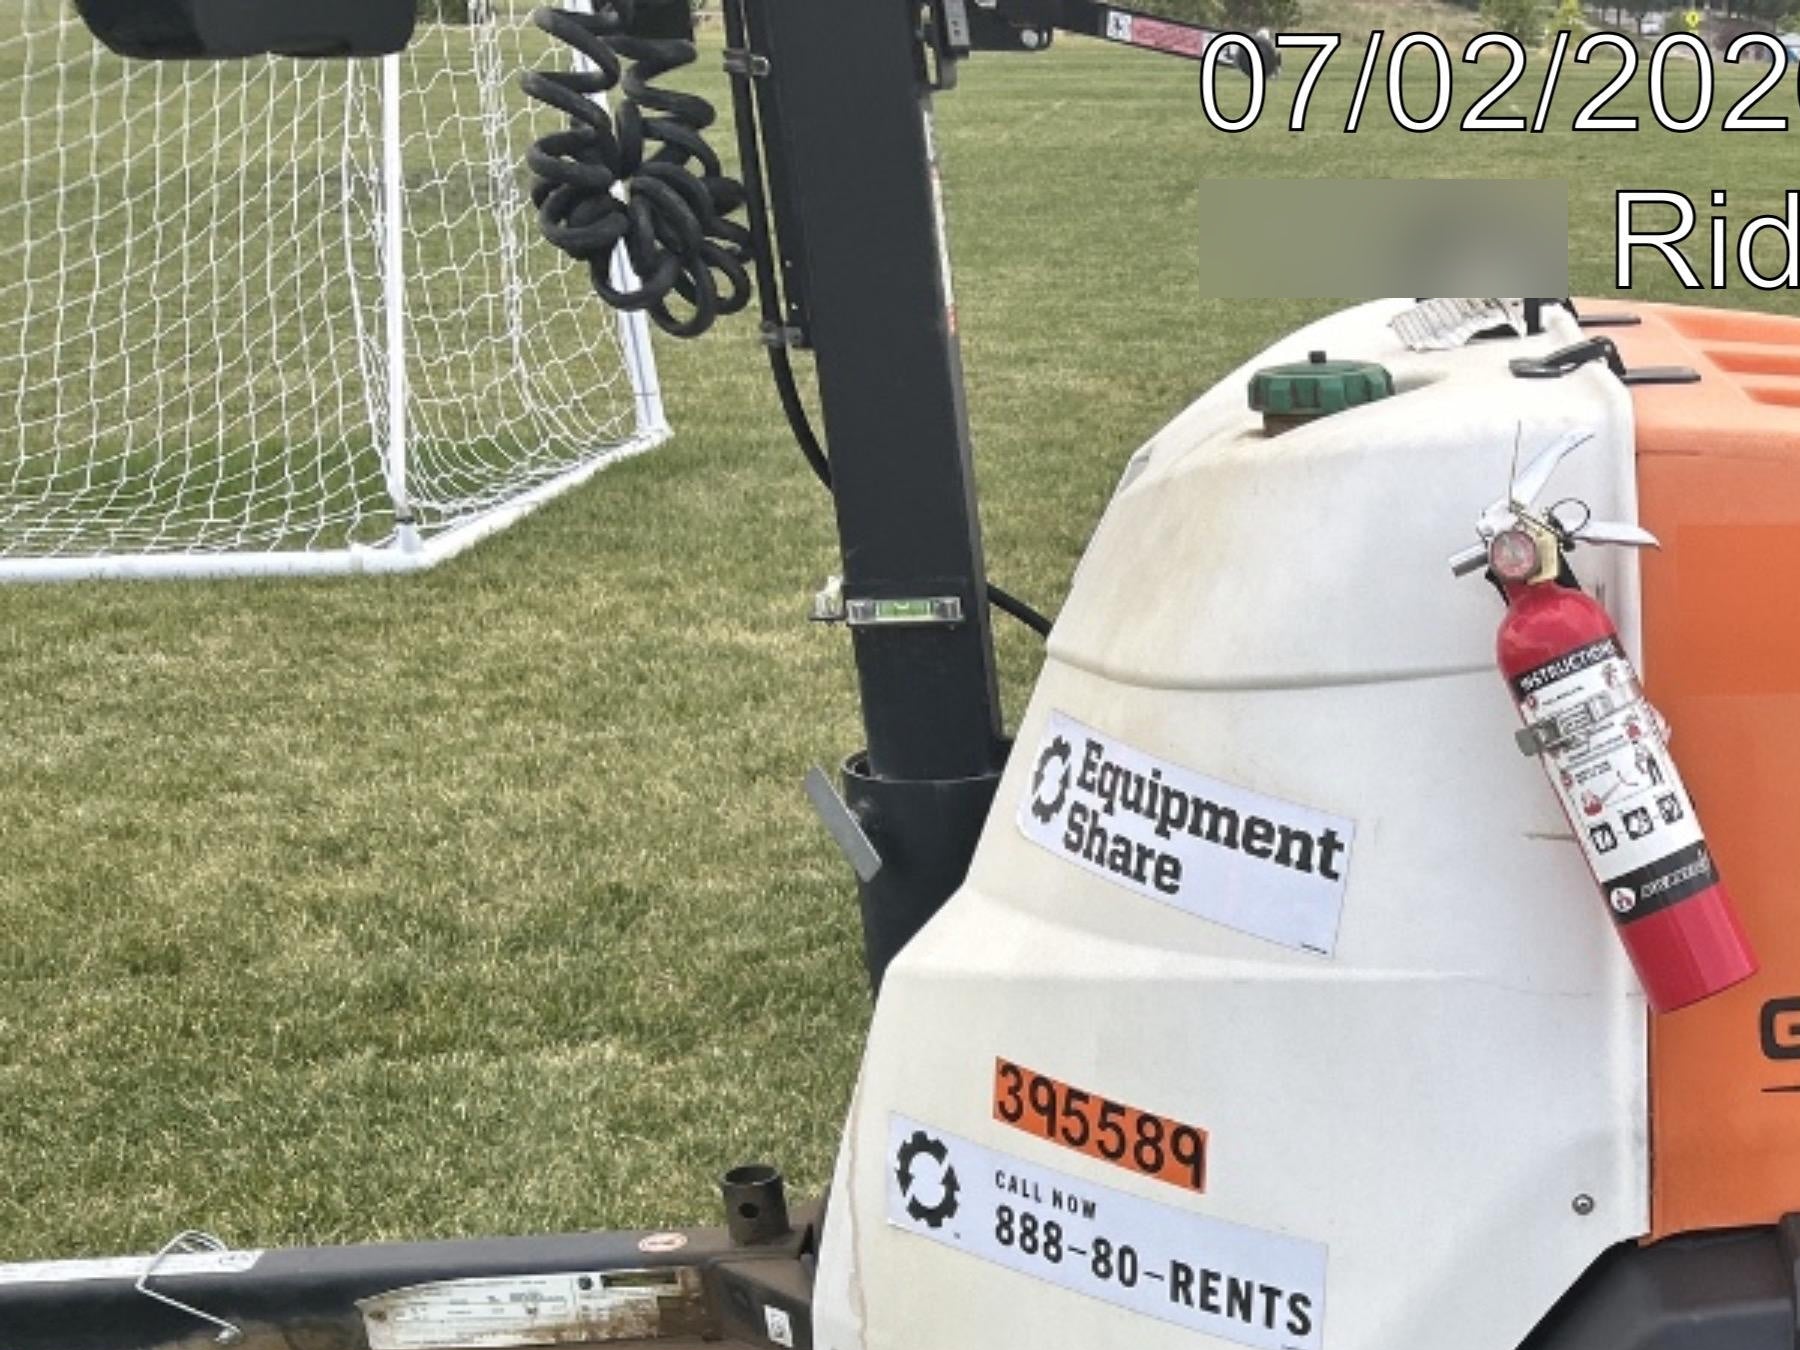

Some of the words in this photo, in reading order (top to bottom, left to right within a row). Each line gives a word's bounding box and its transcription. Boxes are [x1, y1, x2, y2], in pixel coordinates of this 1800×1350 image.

[1062, 799, 1183, 895] Share
[1075, 736, 1345, 883] Equipment
[997, 1061, 1208, 1191] 395589
[994, 1169, 1042, 1204] CALL
[1052, 1187, 1097, 1220] NOW
[993, 1203, 1313, 1338] 888-80-RENTS
